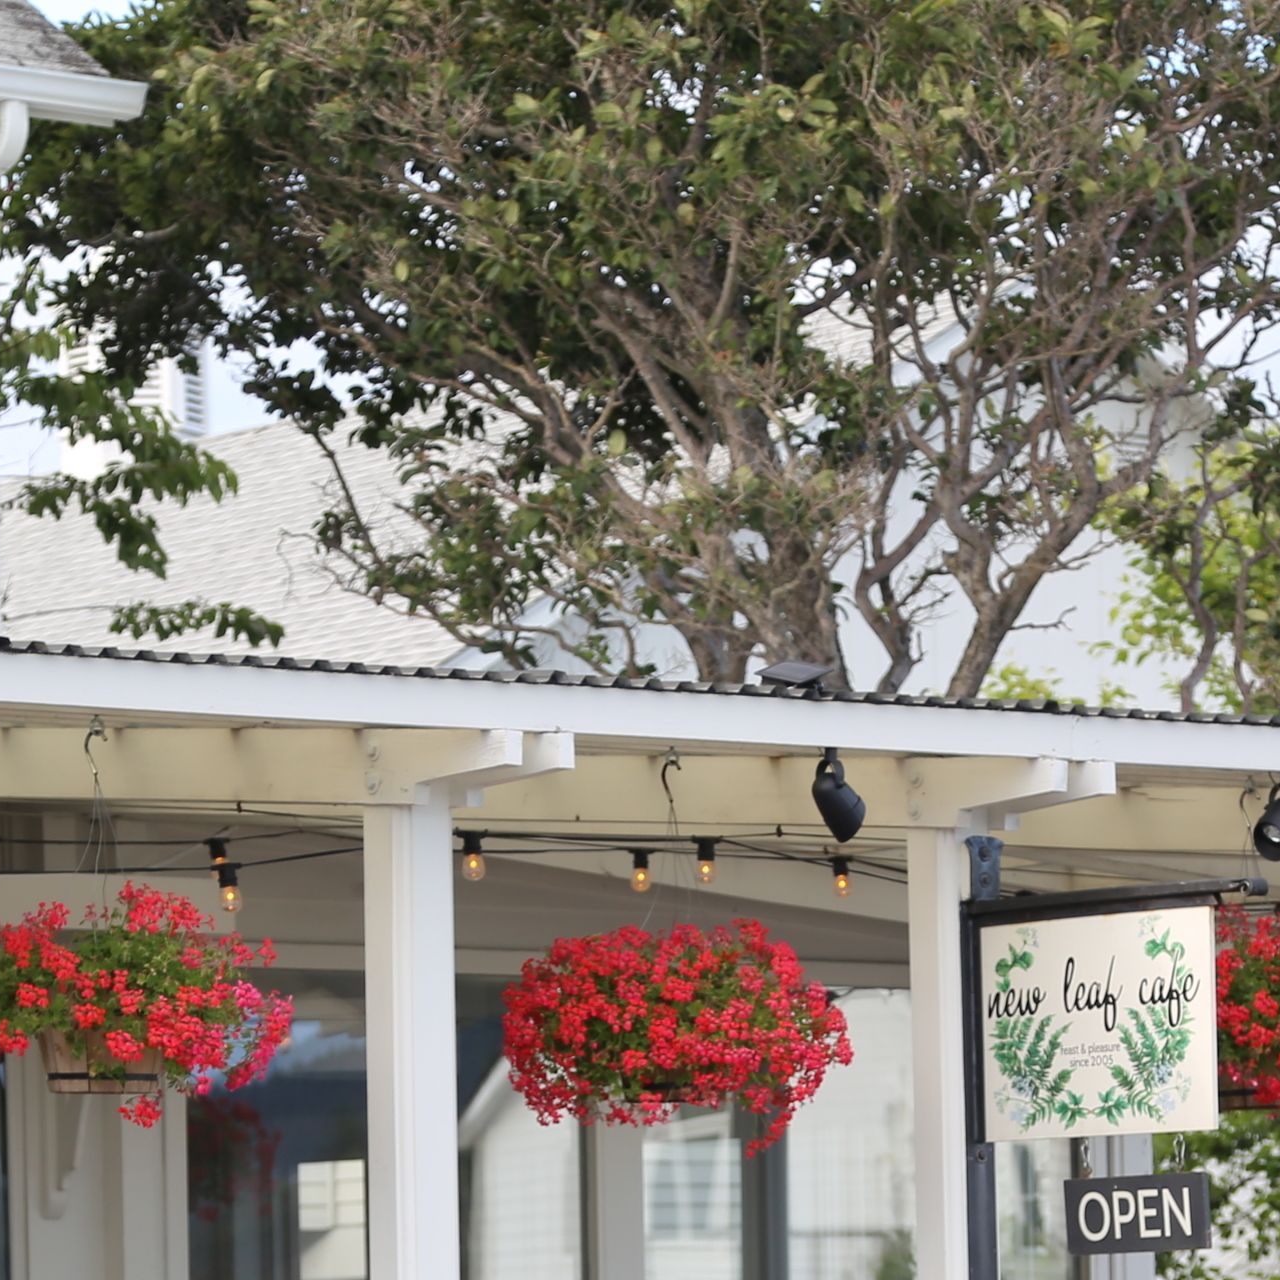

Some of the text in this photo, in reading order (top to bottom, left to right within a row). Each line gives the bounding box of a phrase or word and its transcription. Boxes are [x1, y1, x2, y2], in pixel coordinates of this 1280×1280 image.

[988, 950, 1200, 1032] new leaf cafe
[1069, 1055, 1114, 1067] since 2005
[1088, 1042, 1121, 1056] pleasure
[1078, 1187, 1193, 1242] OPEN
